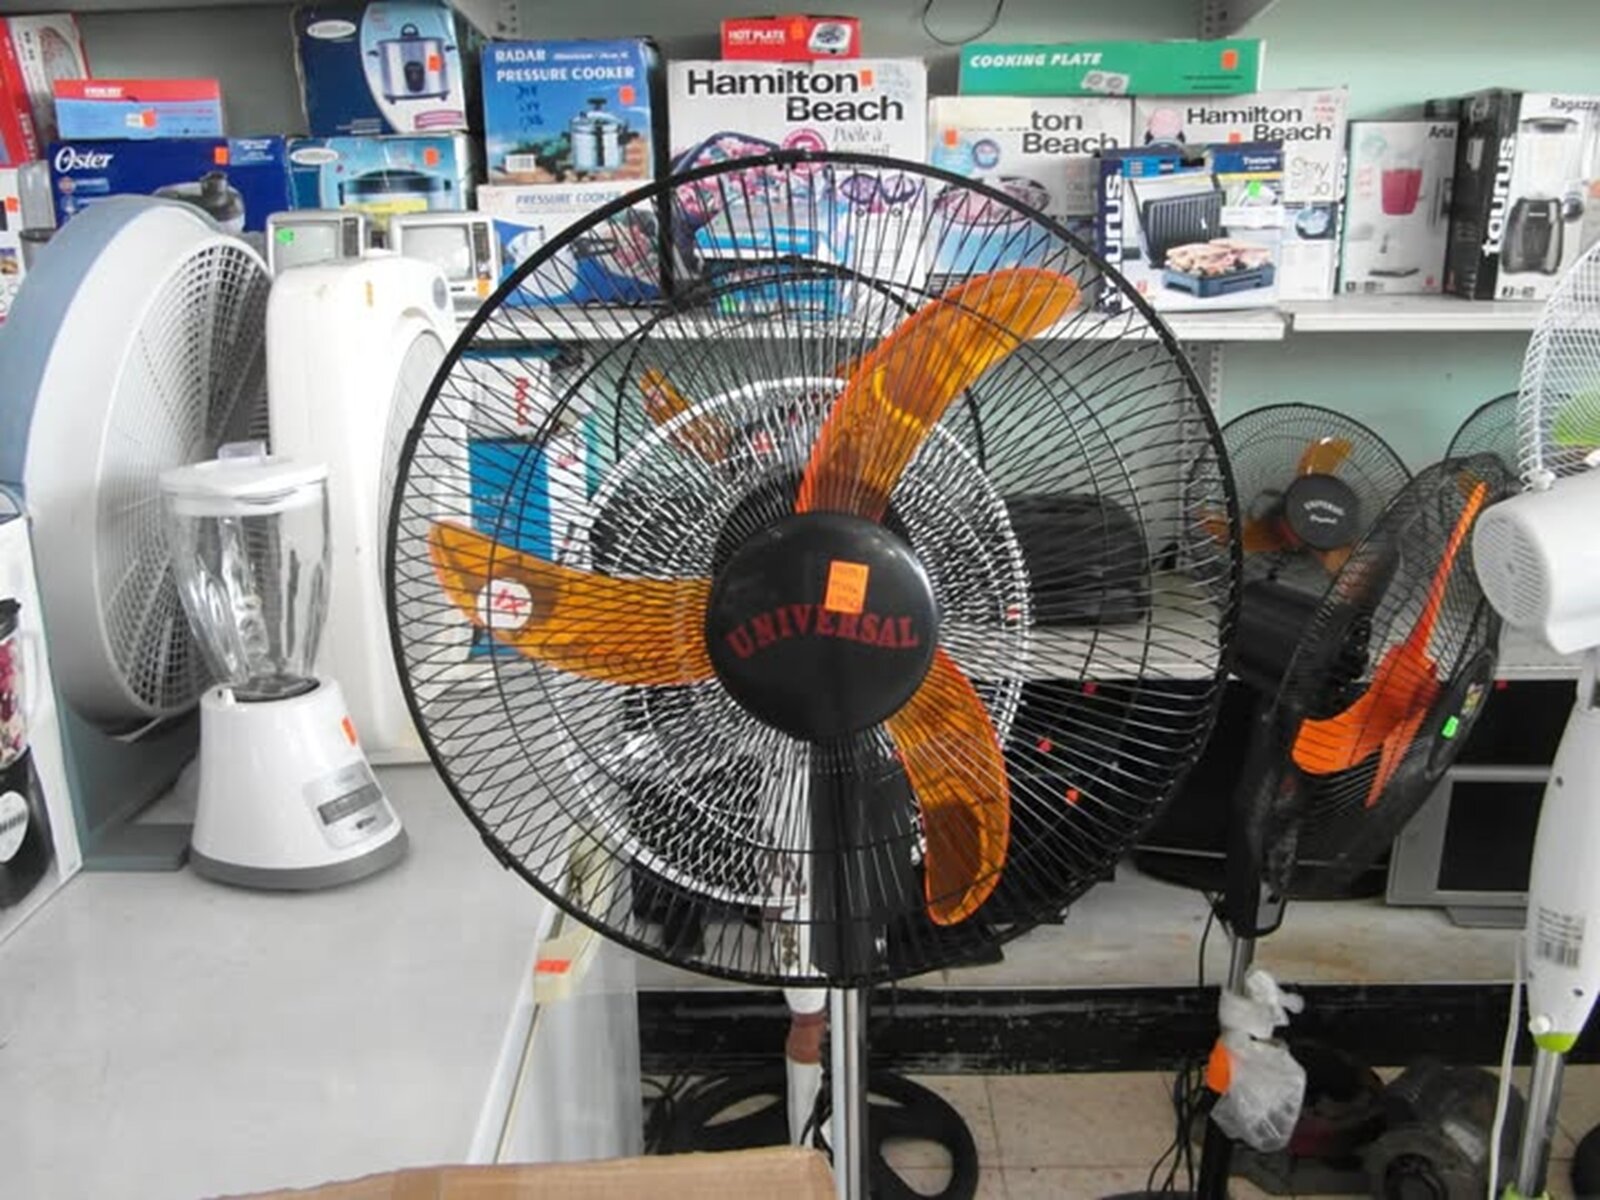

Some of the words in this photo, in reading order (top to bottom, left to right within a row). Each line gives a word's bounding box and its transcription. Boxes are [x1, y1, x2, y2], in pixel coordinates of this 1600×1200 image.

[728, 29, 752, 40] HOT
[754, 29, 785, 40] PLATE
[495, 49, 546, 63] RADAR
[970, 54, 1045, 68] COOKING
[1050, 52, 1103, 66] PLATE
[497, 68, 567, 82] PRESSURE
[572, 65, 635, 81] COOKER
[687, 69, 857, 95] Hamilton
[786, 96, 903, 121] Beach
[1187, 106, 1302, 124] Hamilton
[1252, 124, 1331, 142] Beach
[1428, 125, 1454, 139] Aria
[1022, 132, 1119, 154] Beach
[55, 146, 113, 173] Oster
[1482, 137, 1515, 257] taurus
[724, 603, 920, 660] UNIVERSAL
